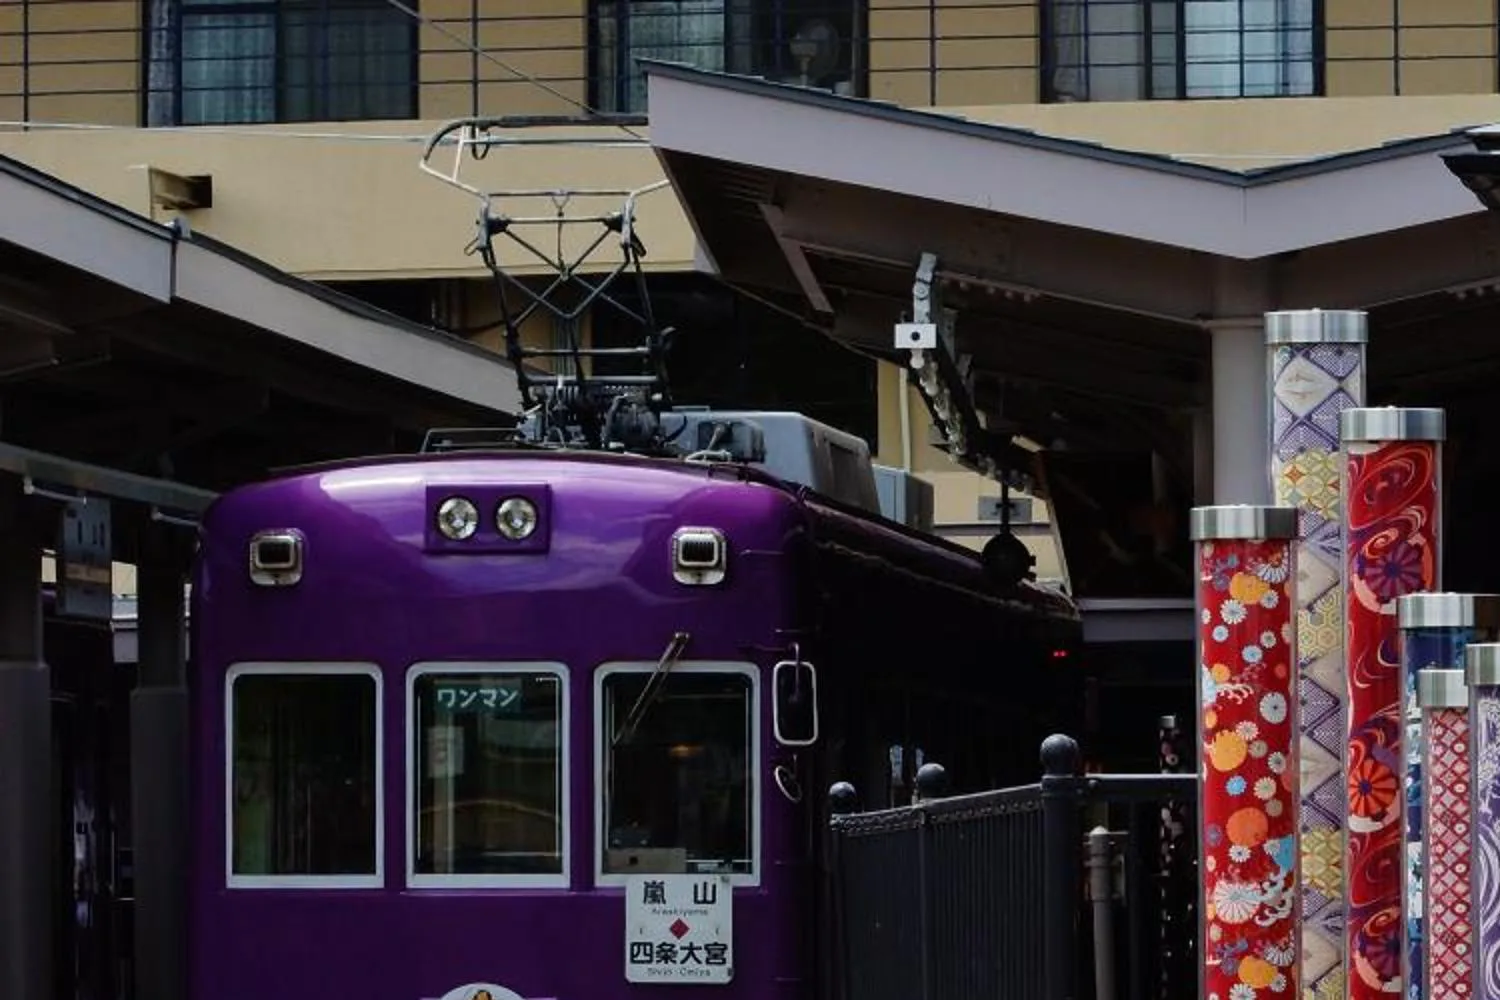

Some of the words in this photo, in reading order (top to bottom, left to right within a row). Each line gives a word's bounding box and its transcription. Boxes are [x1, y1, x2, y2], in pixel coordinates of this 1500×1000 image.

[437, 688, 519, 708] ワンマン
[643, 880, 717, 905] 嵐山
[630, 941, 728, 965] 四条大宮
